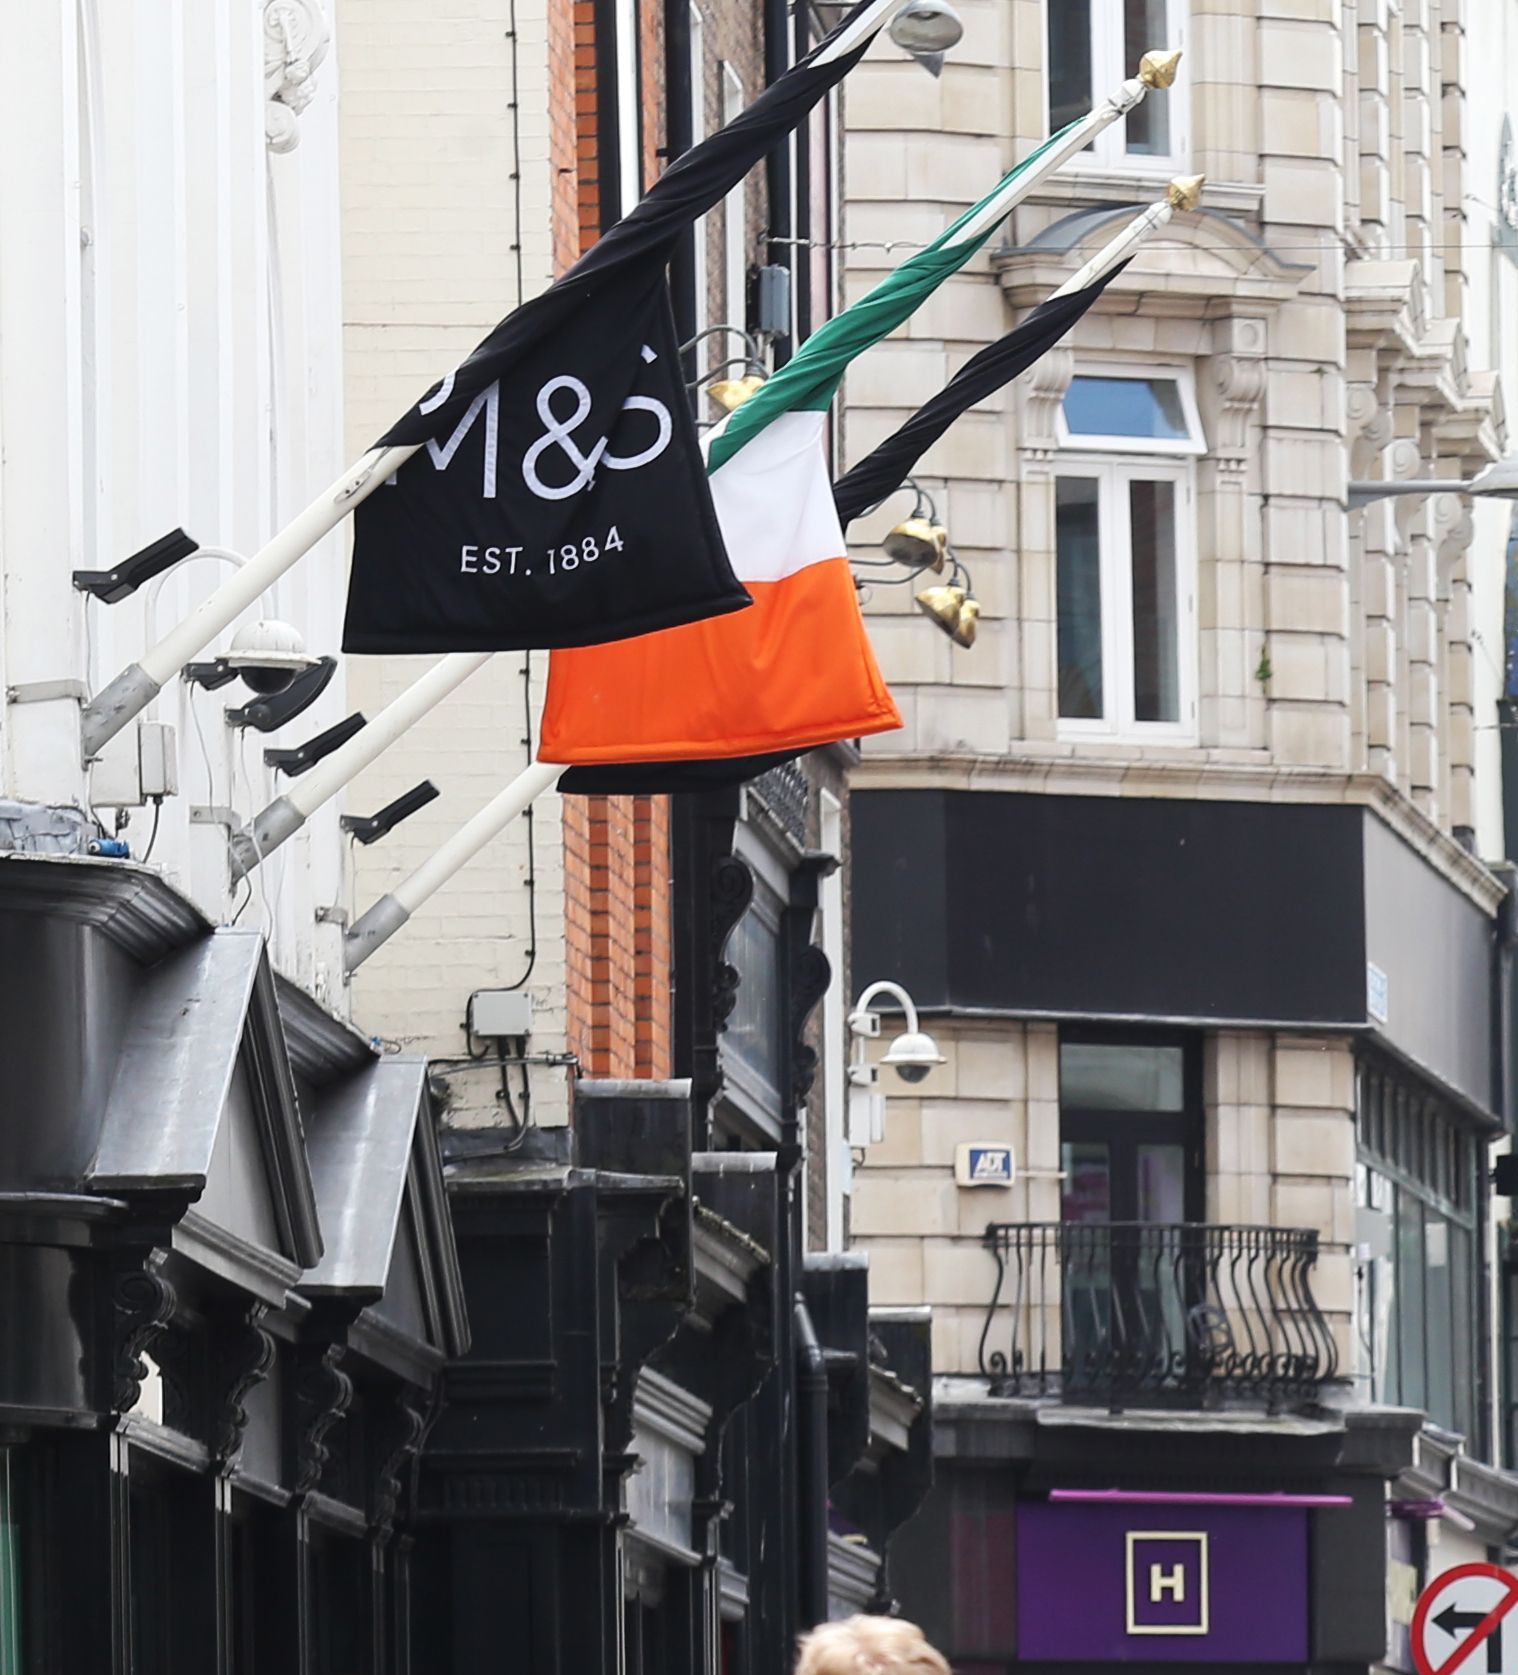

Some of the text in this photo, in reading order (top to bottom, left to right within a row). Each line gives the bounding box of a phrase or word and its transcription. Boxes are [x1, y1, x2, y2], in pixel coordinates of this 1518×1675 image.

[460, 525, 624, 577] EST. 1884
[1150, 1563, 1184, 1602] H
